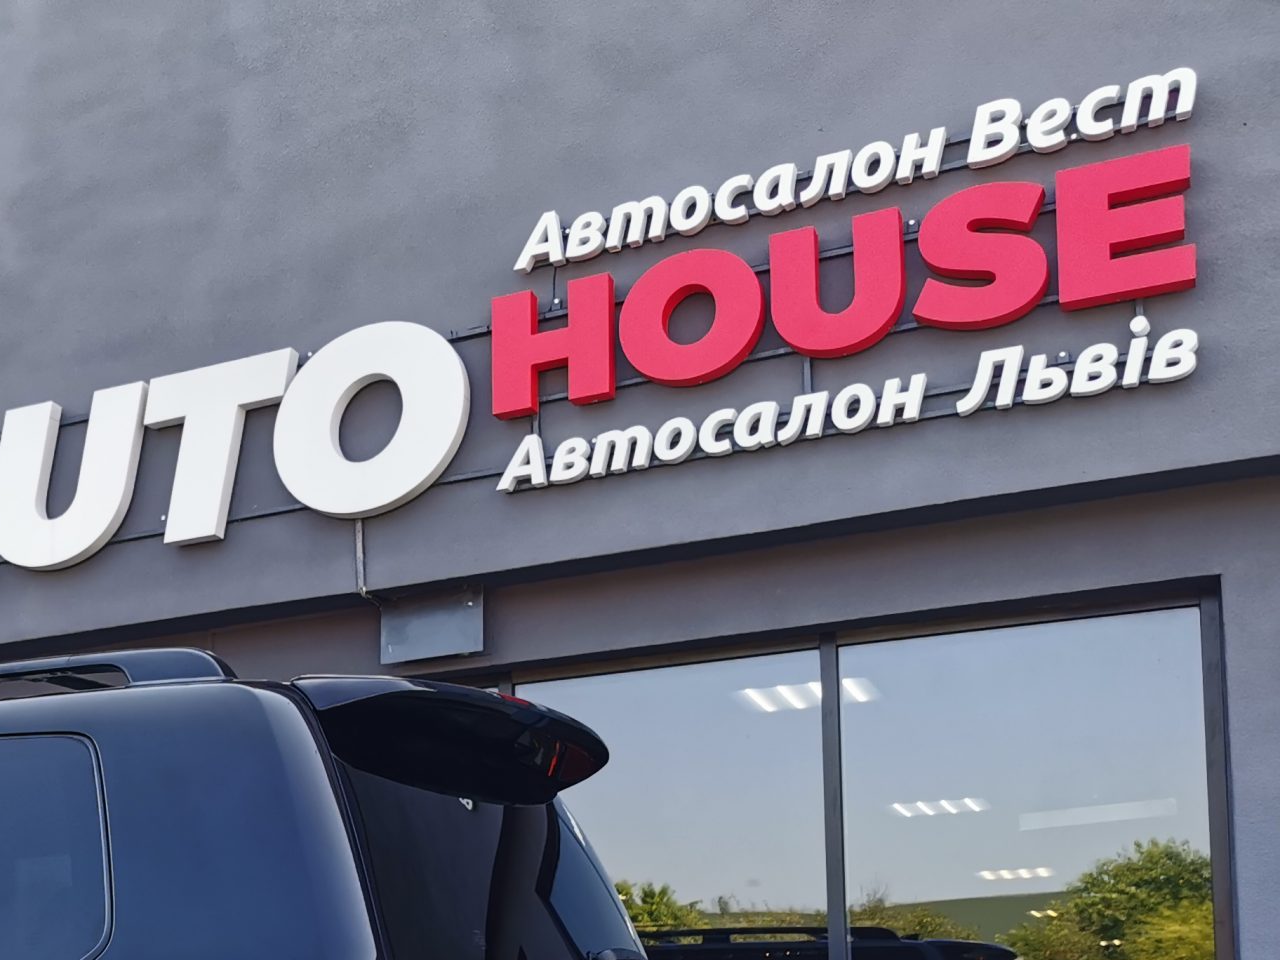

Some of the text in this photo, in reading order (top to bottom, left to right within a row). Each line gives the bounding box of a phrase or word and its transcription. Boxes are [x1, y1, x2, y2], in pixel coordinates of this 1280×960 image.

[513, 67, 1198, 273] Автосалон Вест
[491, 144, 1197, 420] HOUSE
[496, 315, 1199, 492] Автосалон Львів
